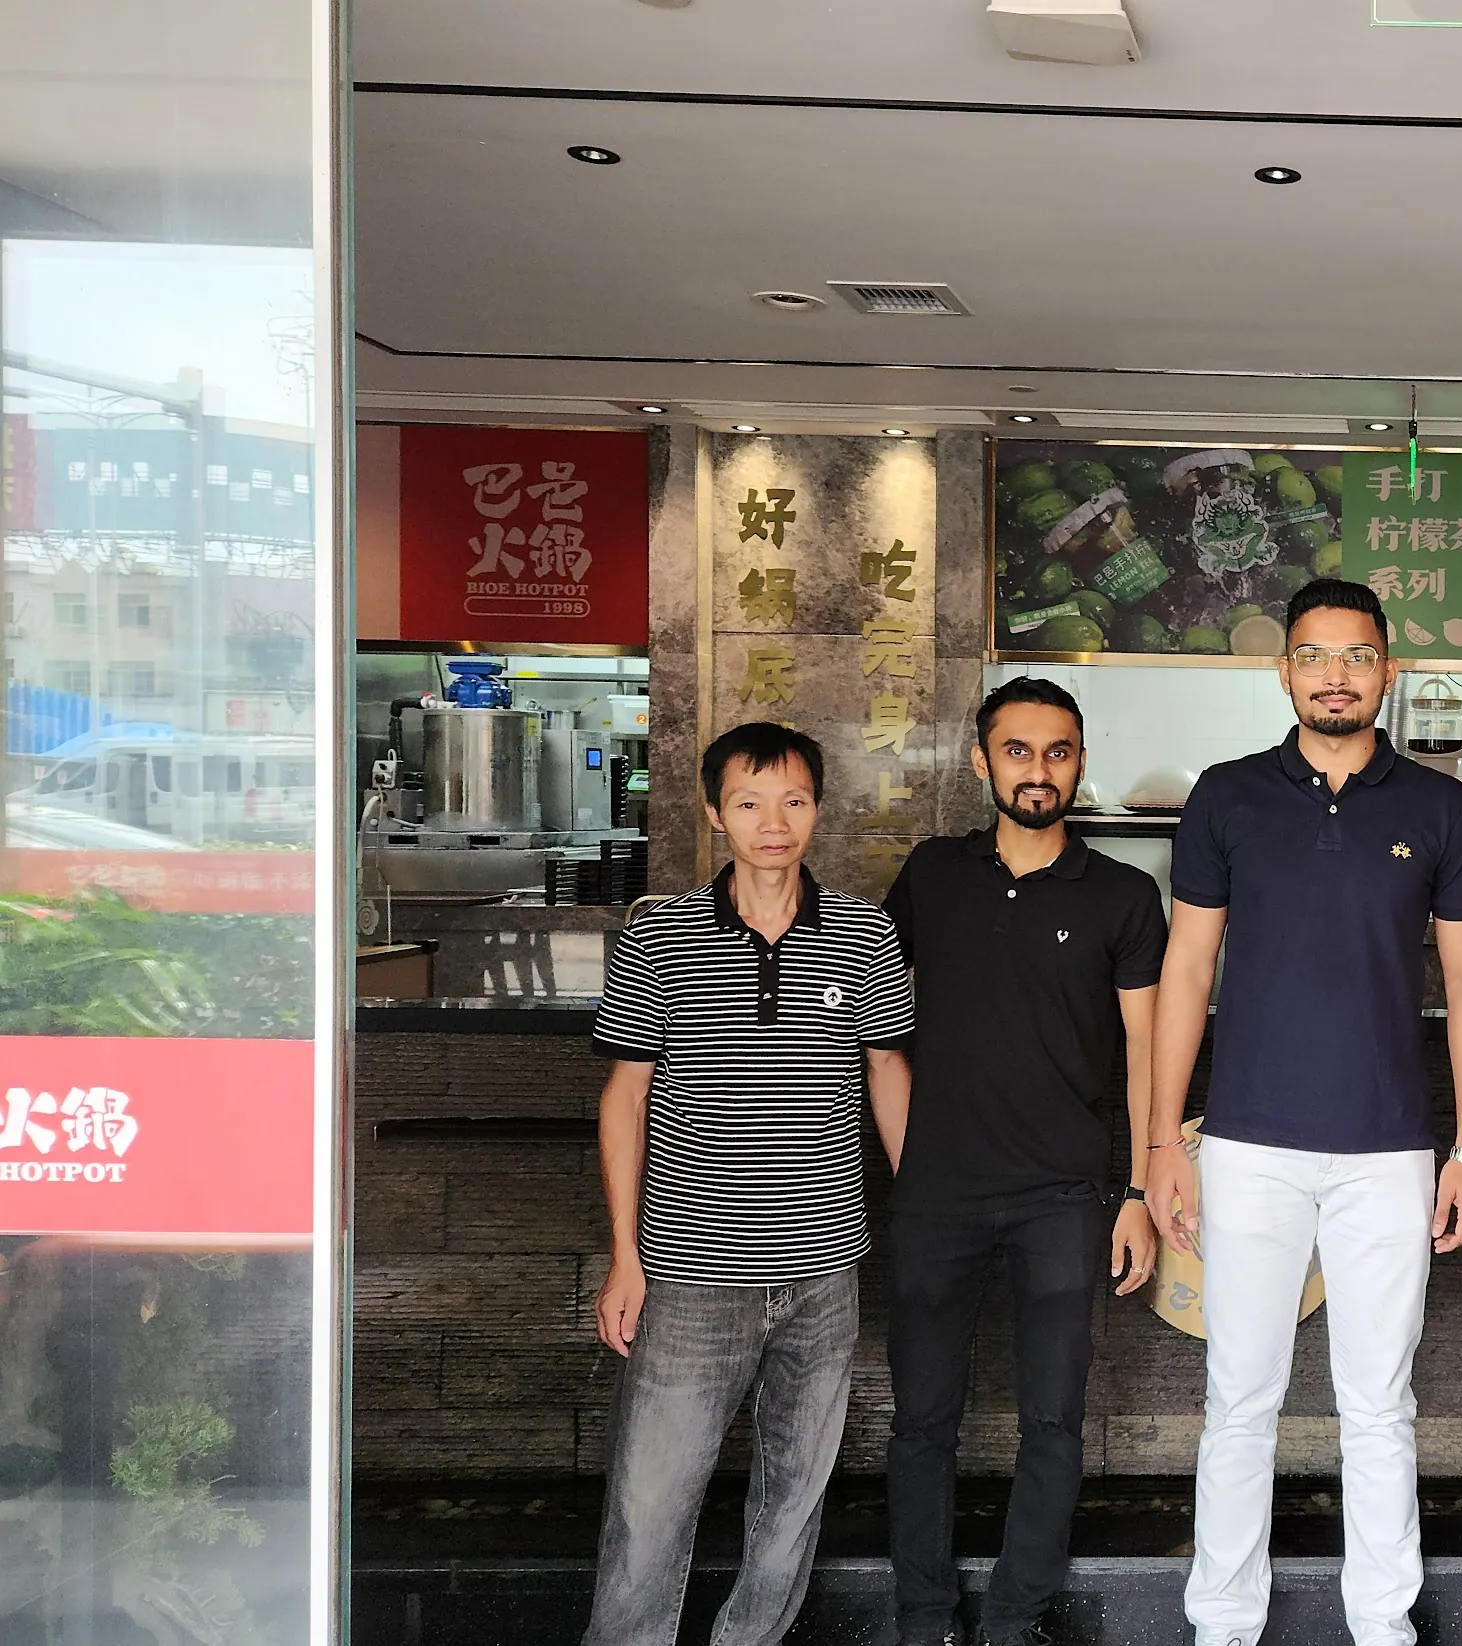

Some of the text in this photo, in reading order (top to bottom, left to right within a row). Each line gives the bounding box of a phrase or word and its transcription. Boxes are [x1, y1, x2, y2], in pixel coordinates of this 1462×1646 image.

[462, 461, 588, 522] 巴邑
[1366, 465, 1448, 502] 手打
[466, 582, 588, 596] BIOE HOTPOT
[1109, 567, 1139, 591] LEMON
[1368, 565, 1447, 602] 系列
[543, 602, 584, 614] 1998
[738, 488, 797, 730] 好锅底
[0, 1162, 127, 1182] HOTPOT
